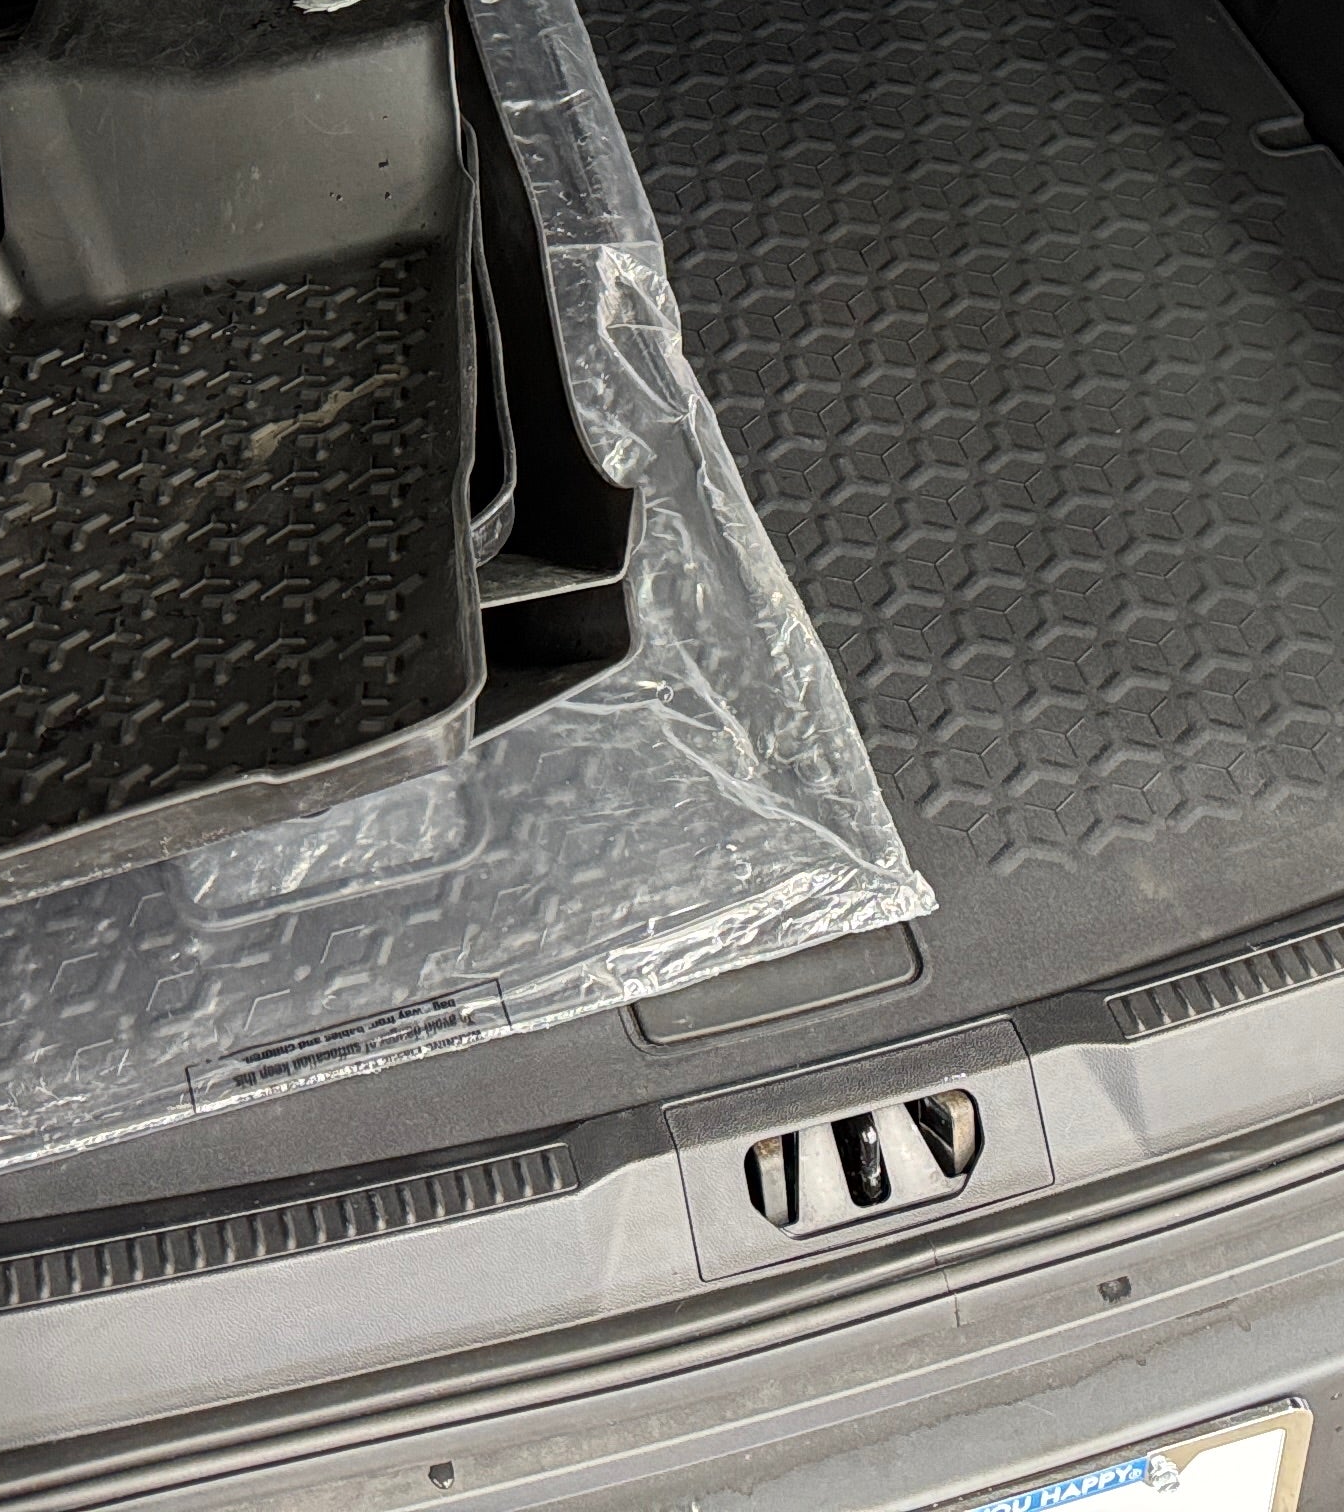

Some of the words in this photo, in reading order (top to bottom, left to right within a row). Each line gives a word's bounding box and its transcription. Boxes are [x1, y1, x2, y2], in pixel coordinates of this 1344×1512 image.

[432, 998, 456, 1011] bag
[424, 1013, 457, 1034] avoid
[323, 1024, 365, 1042] babies
[297, 1039, 321, 1050] and
[293, 1041, 362, 1070] suffocation
[259, 1060, 291, 1079] keep
[232, 1071, 258, 1089] this
[983, 1495, 1032, 1512] OU
